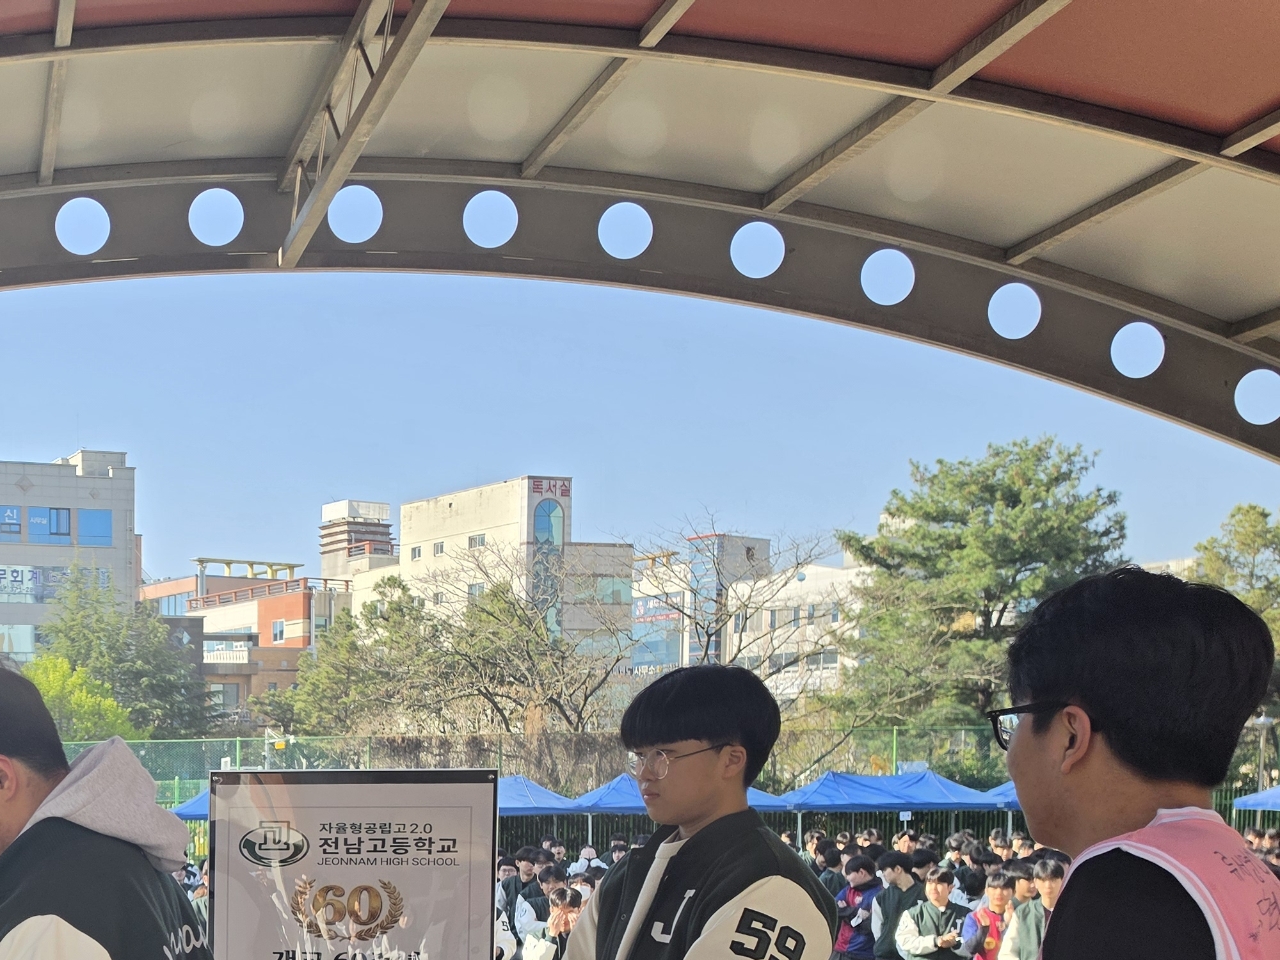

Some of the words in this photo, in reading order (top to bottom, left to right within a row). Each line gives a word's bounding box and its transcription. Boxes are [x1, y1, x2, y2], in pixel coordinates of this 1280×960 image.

[532, 480, 571, 498] 독서실
[318, 836, 459, 856] 전남고등학교
[317, 857, 377, 867] JEONNAM
[380, 857, 409, 867] HIGH
[411, 857, 461, 867] SCHOOL
[312, 884, 383, 926] 60
[650, 889, 696, 944] J
